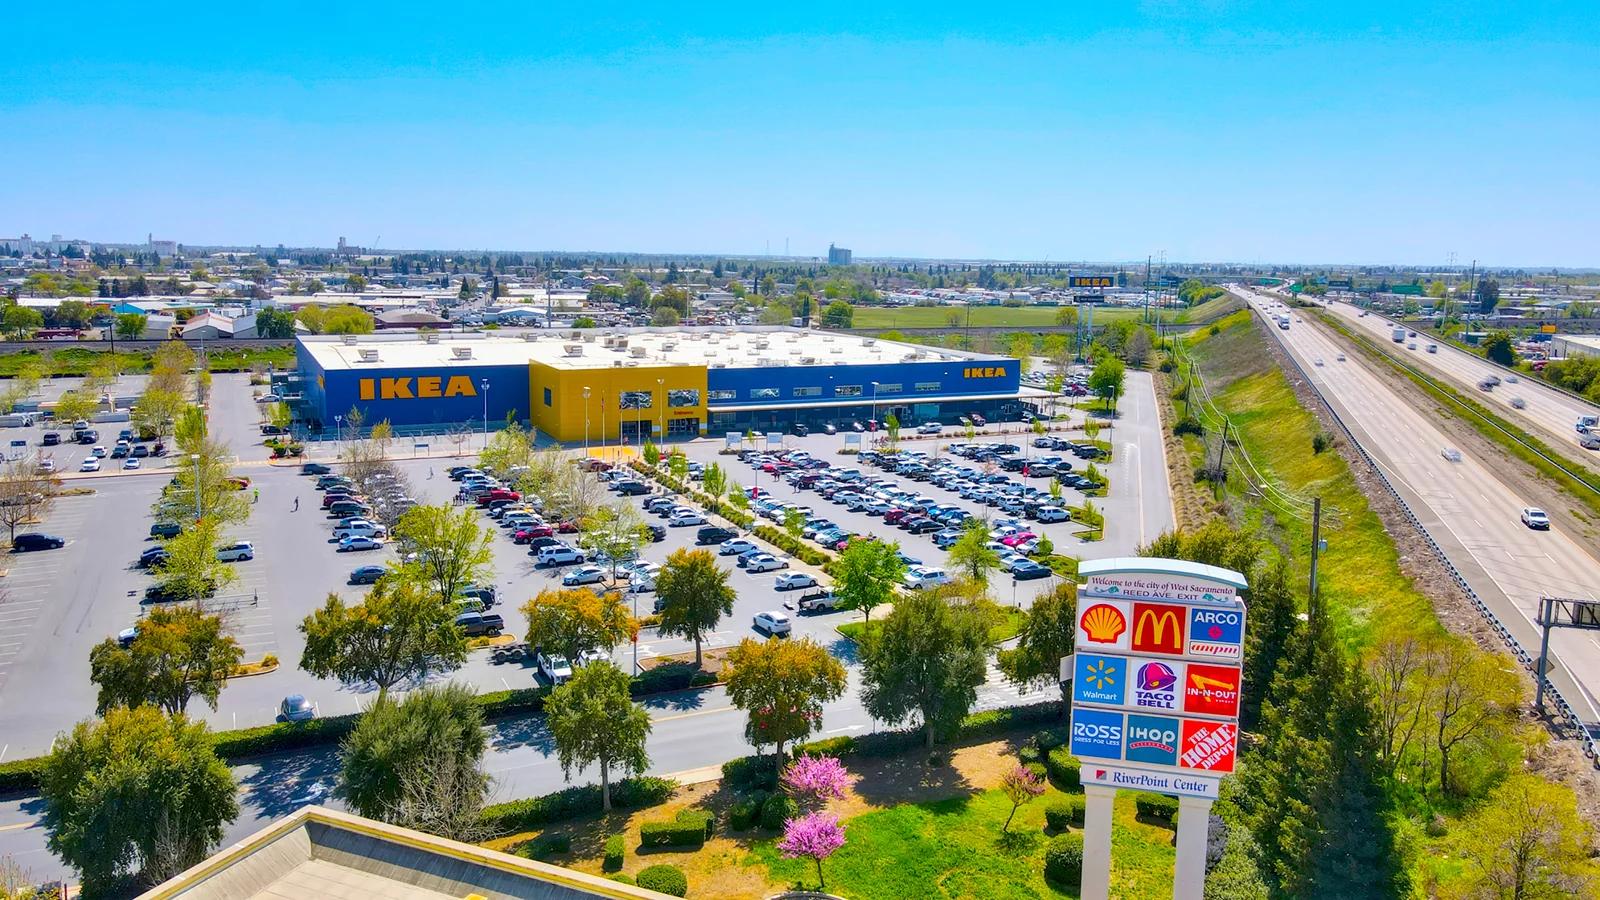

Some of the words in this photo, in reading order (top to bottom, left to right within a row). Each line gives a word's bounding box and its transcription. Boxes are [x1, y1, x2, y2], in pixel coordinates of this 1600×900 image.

[1075, 278, 1111, 286] IKEA
[964, 367, 1006, 378] IKEA
[359, 375, 477, 400] IKEA
[1092, 577, 1123, 586] Welcome
[1134, 580, 1145, 588] the
[1146, 581, 1160, 590] city
[1161, 582, 1169, 591] of
[1171, 583, 1188, 591] West
[1190, 585, 1233, 595] Sacramento
[1123, 589, 1150, 597] REED
[1152, 591, 1174, 599] AVE.
[1194, 611, 1238, 625] ARCO
[1191, 644, 1237, 654] ampm
[1083, 690, 1117, 701] Walmart
[1135, 691, 1175, 701] TACO
[1187, 687, 1236, 699] IN-N-OUT
[1137, 699, 1175, 709] BELL
[1074, 722, 1121, 739] ROSS
[1129, 726, 1176, 745] IHOP
[1187, 727, 1210, 745] THE
[1181, 724, 1236, 768] HOME
[1200, 741, 1235, 770] DEPOT
[1113, 772, 1169, 788] RiverPoint
[1173, 778, 1208, 792] Center
